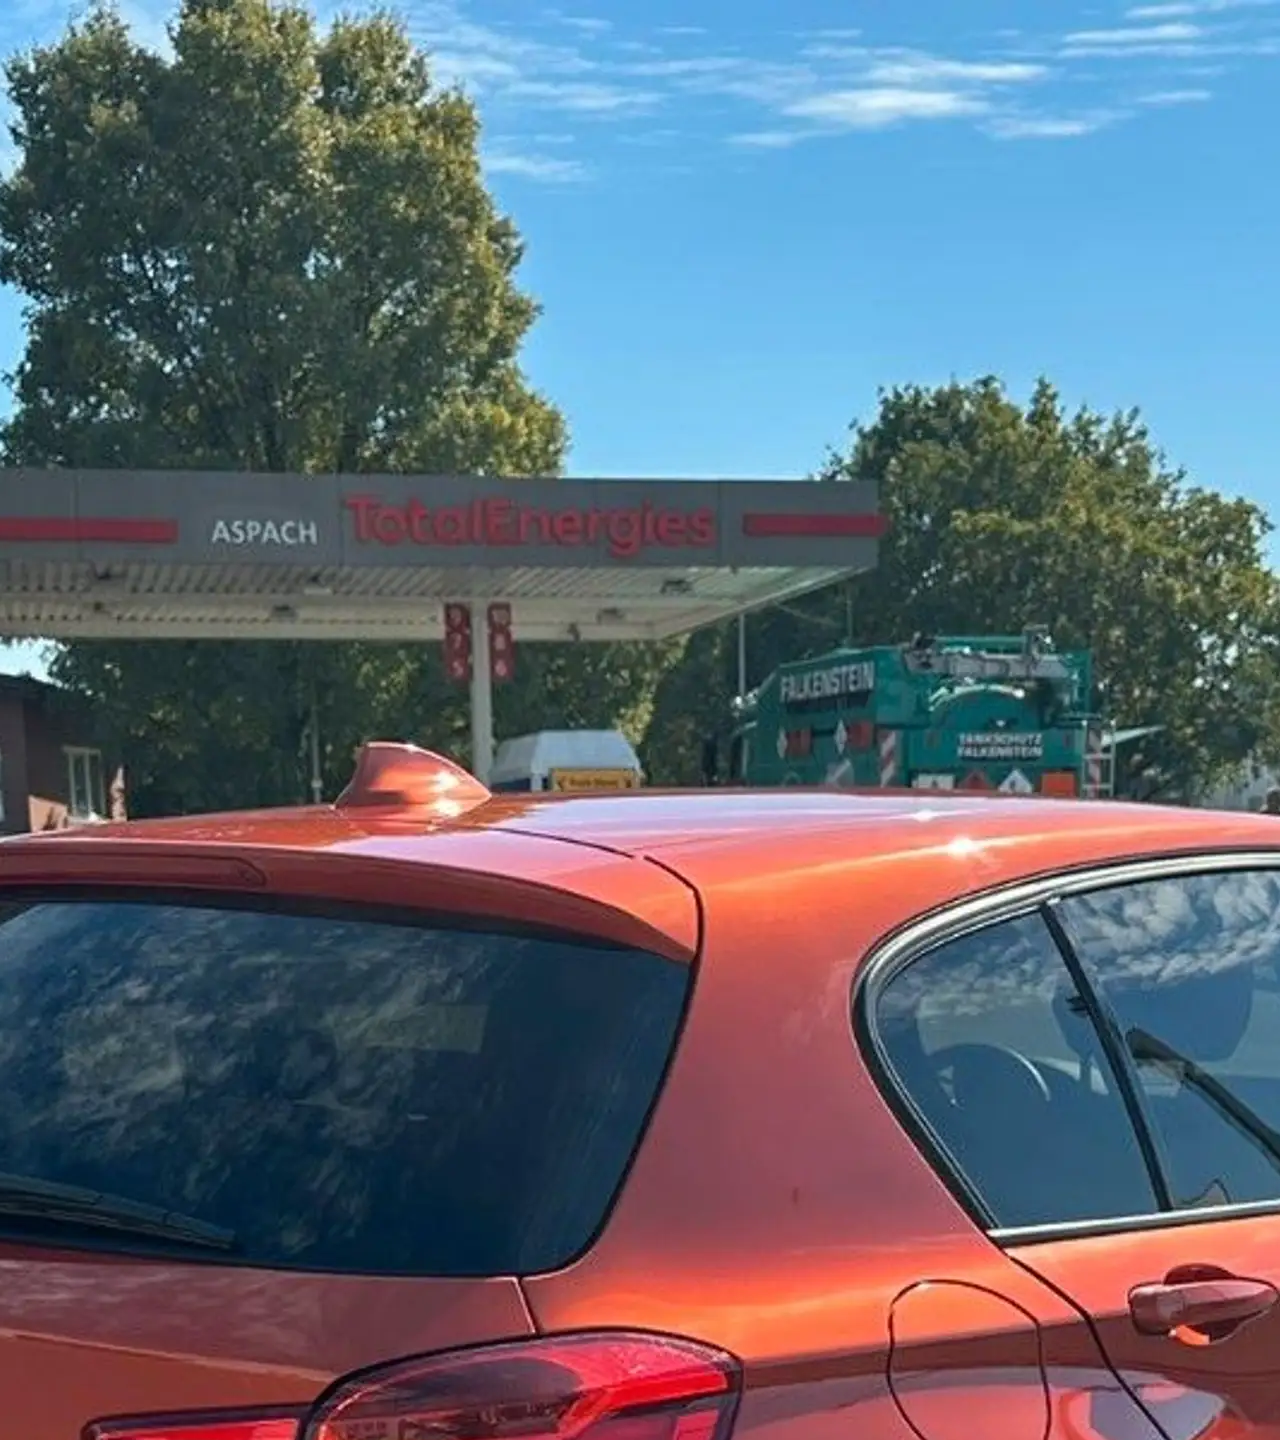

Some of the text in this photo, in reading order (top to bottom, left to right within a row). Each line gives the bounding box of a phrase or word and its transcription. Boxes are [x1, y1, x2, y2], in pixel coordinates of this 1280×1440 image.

[211, 519, 319, 545] ASPACH
[344, 494, 718, 558] TotalEnergies
[780, 660, 876, 704] FALKENSTEIN
